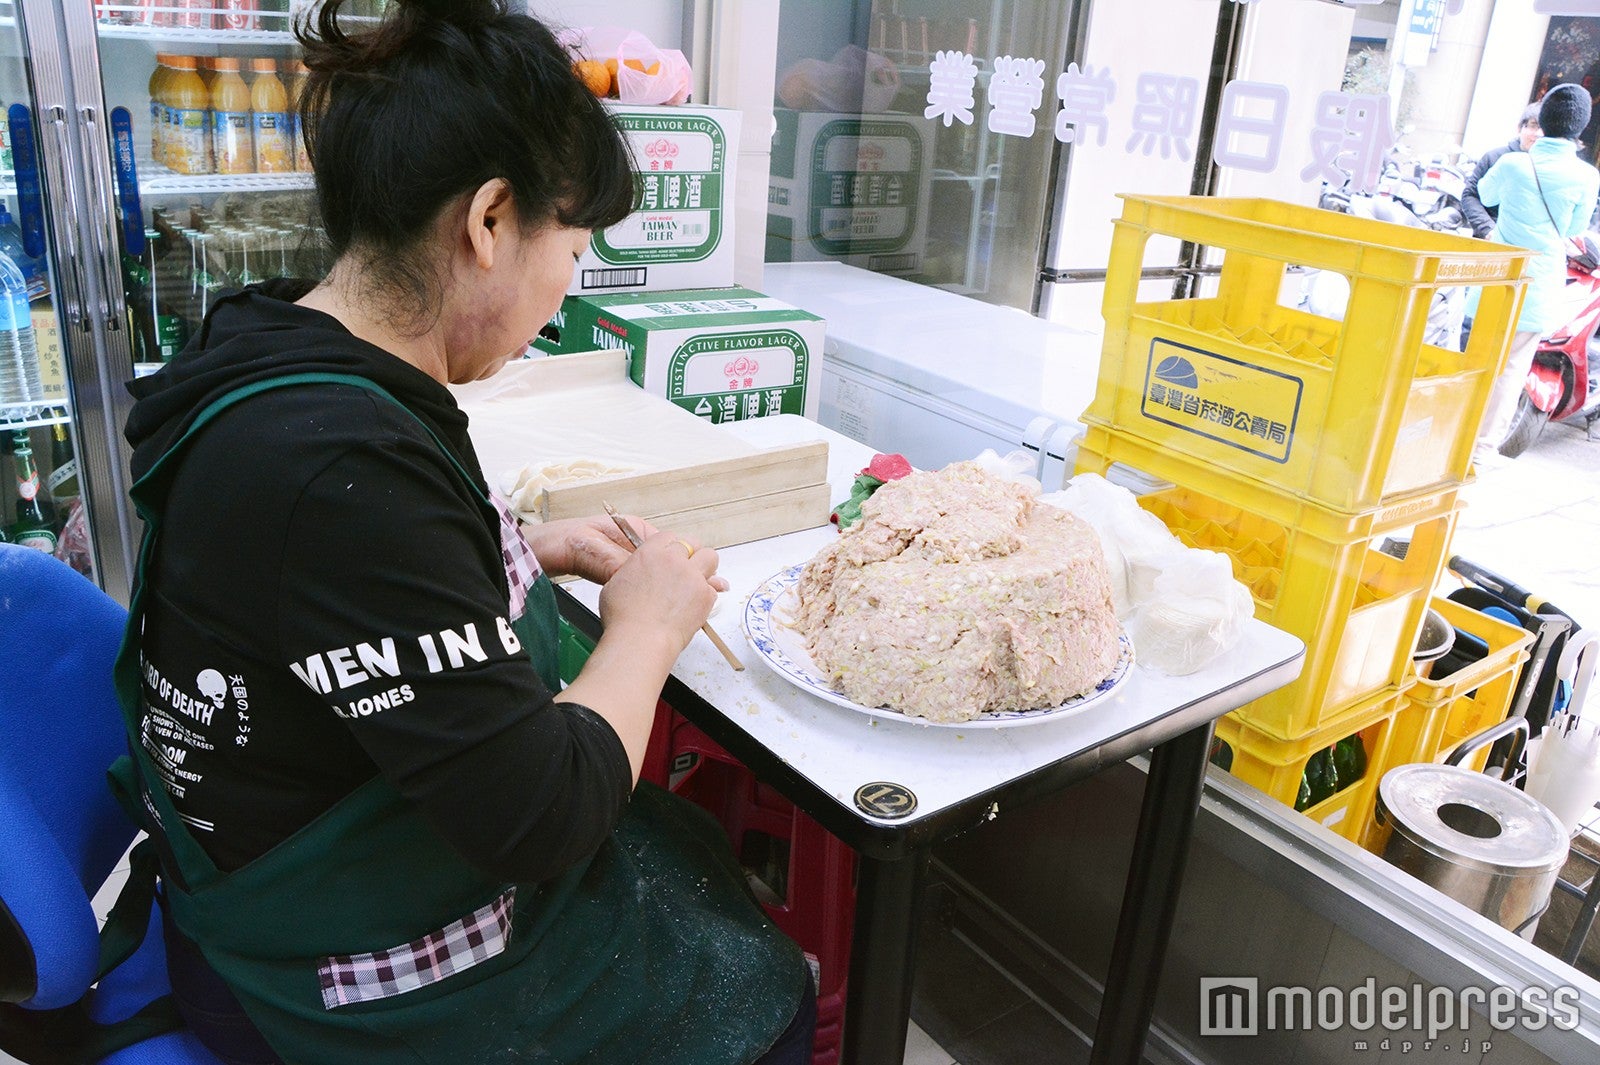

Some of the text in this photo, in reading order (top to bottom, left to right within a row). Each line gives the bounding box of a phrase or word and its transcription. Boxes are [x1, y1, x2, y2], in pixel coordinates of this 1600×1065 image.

[645, 121, 683, 130] FLAVOR
[687, 121, 719, 138] LAGER
[712, 143, 722, 170] BEER
[650, 160, 674, 171] 金牌
[642, 221, 678, 231] TAIWAN
[646, 231, 674, 242] BEER
[592, 325, 633, 361] TAIWAN
[674, 335, 805, 395] DISTINCTIVE FLAVOR LAGER BEER
[729, 377, 754, 390] 金牌
[289, 637, 402, 695] MEN
[418, 623, 488, 673] IN
[160, 678, 172, 701] OF
[172, 687, 215, 726] DEATH
[172, 731, 183, 742] OR
[174, 768, 203, 783] ENERGY
